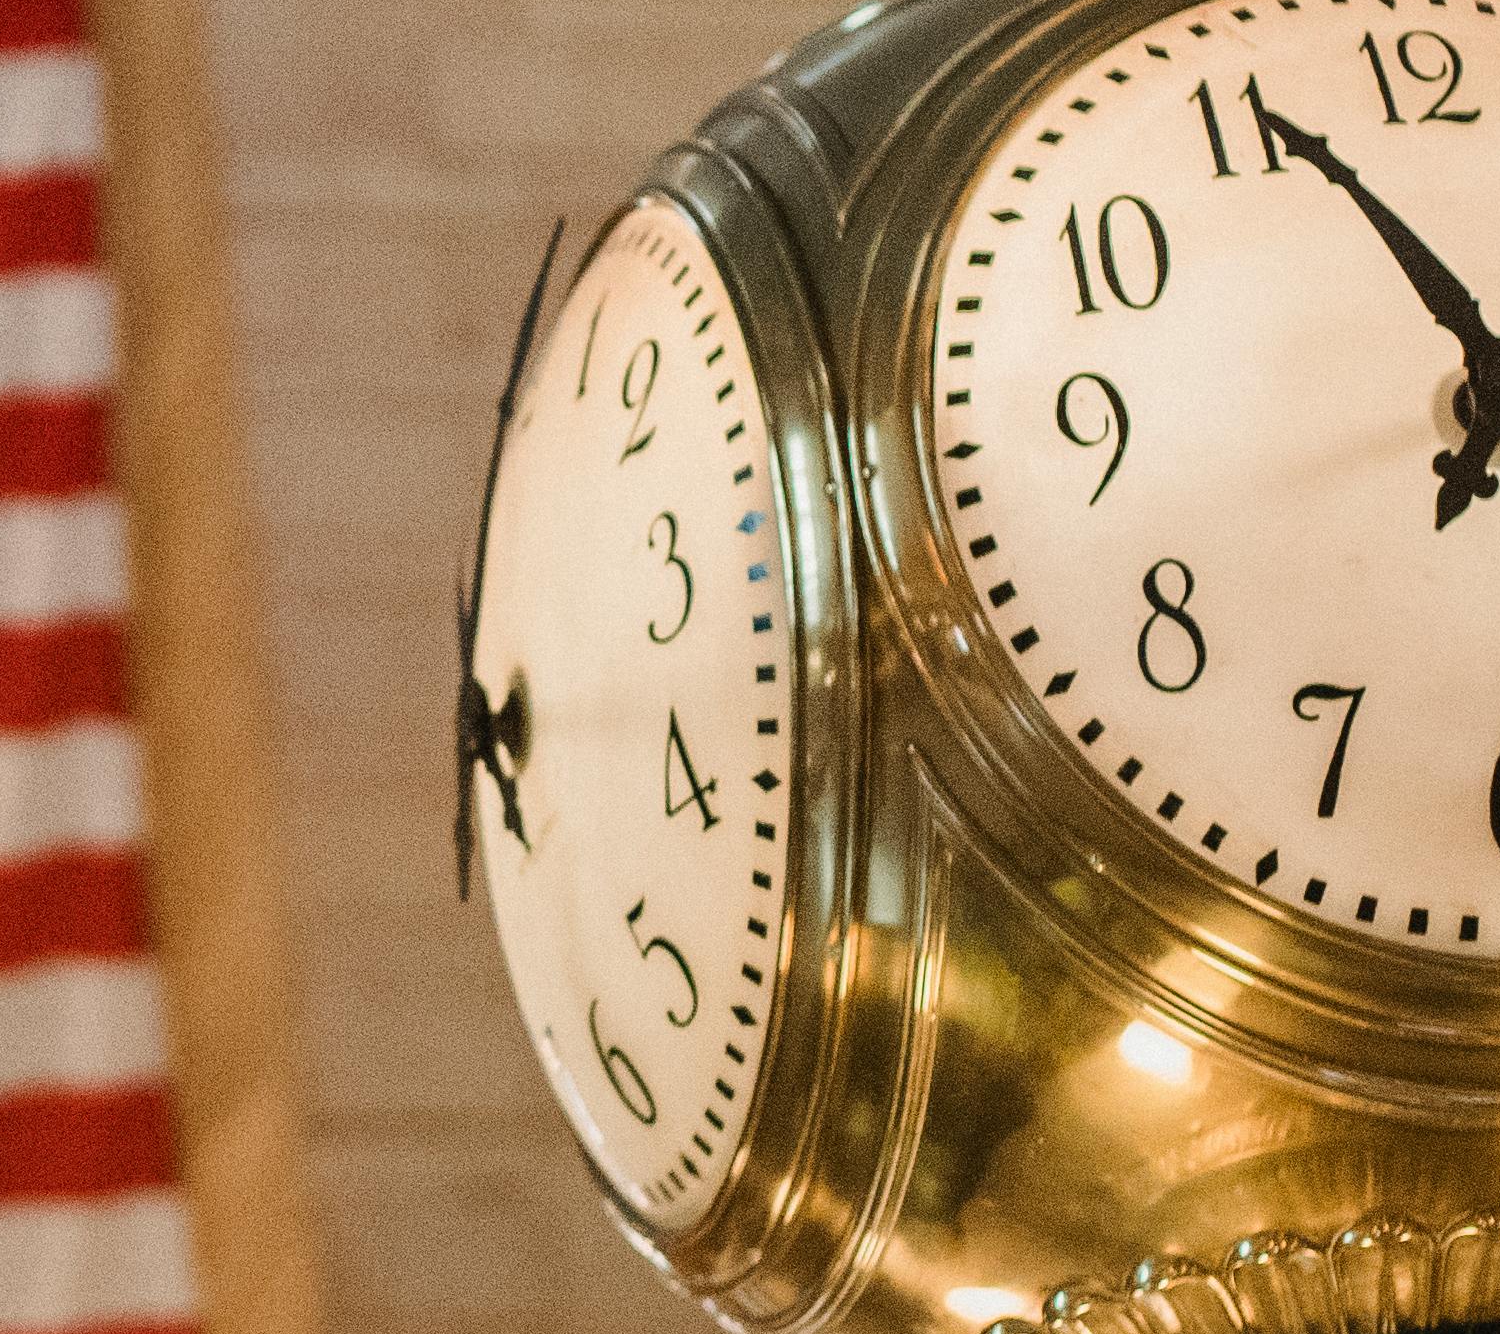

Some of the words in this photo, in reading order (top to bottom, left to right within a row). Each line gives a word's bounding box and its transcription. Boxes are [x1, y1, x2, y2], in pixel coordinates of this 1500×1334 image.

[1188, 72, 1289, 178] 11
[1358, 30, 1482, 125] 12
[1059, 194, 1171, 317] 10
[619, 339, 661, 464] 2
[1055, 372, 1131, 507] 9
[647, 511, 695, 645] 3
[1137, 558, 1207, 694] 8
[665, 707, 721, 833] 4
[1292, 682, 1366, 819] 7
[625, 897, 699, 1029] 5
[588, 999, 658, 1128] 6
